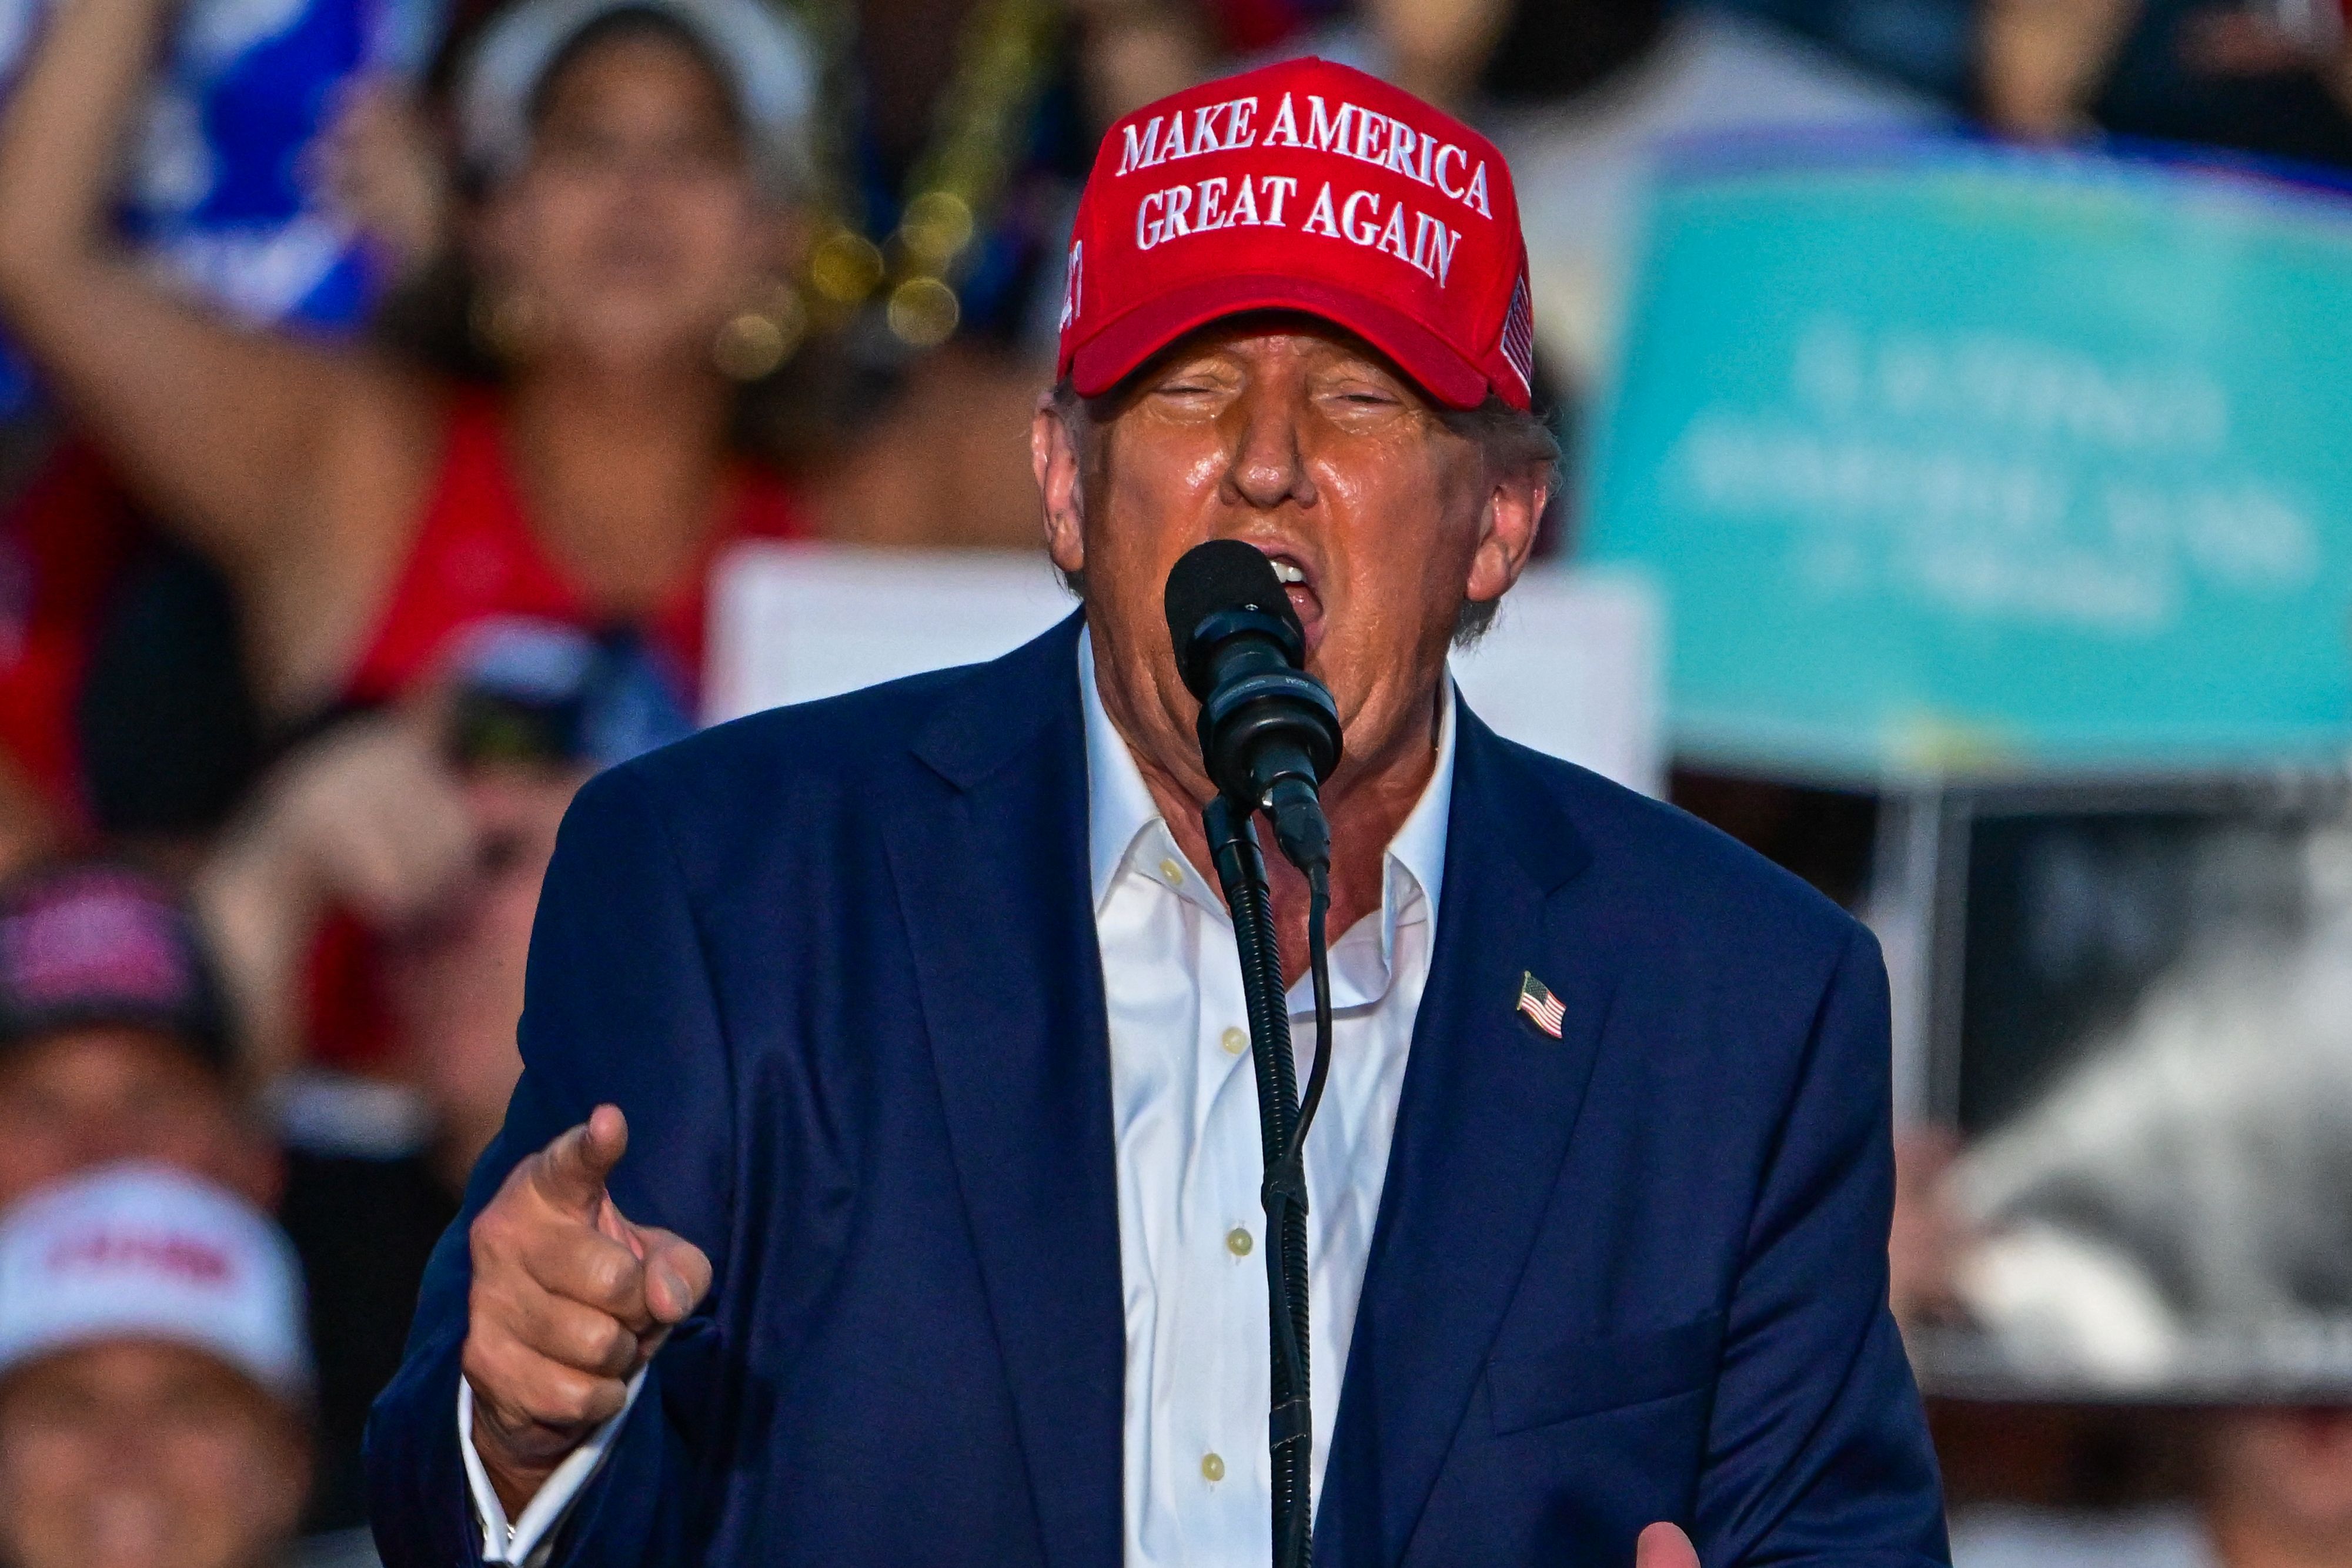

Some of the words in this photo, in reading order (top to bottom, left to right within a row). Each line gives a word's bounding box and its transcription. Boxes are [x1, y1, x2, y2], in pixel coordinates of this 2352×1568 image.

[1115, 96, 1259, 177] MAKE
[1262, 91, 1494, 220] AMERICA
[1136, 173, 1298, 251] GREAT
[1301, 180, 1462, 289] AGAIN
